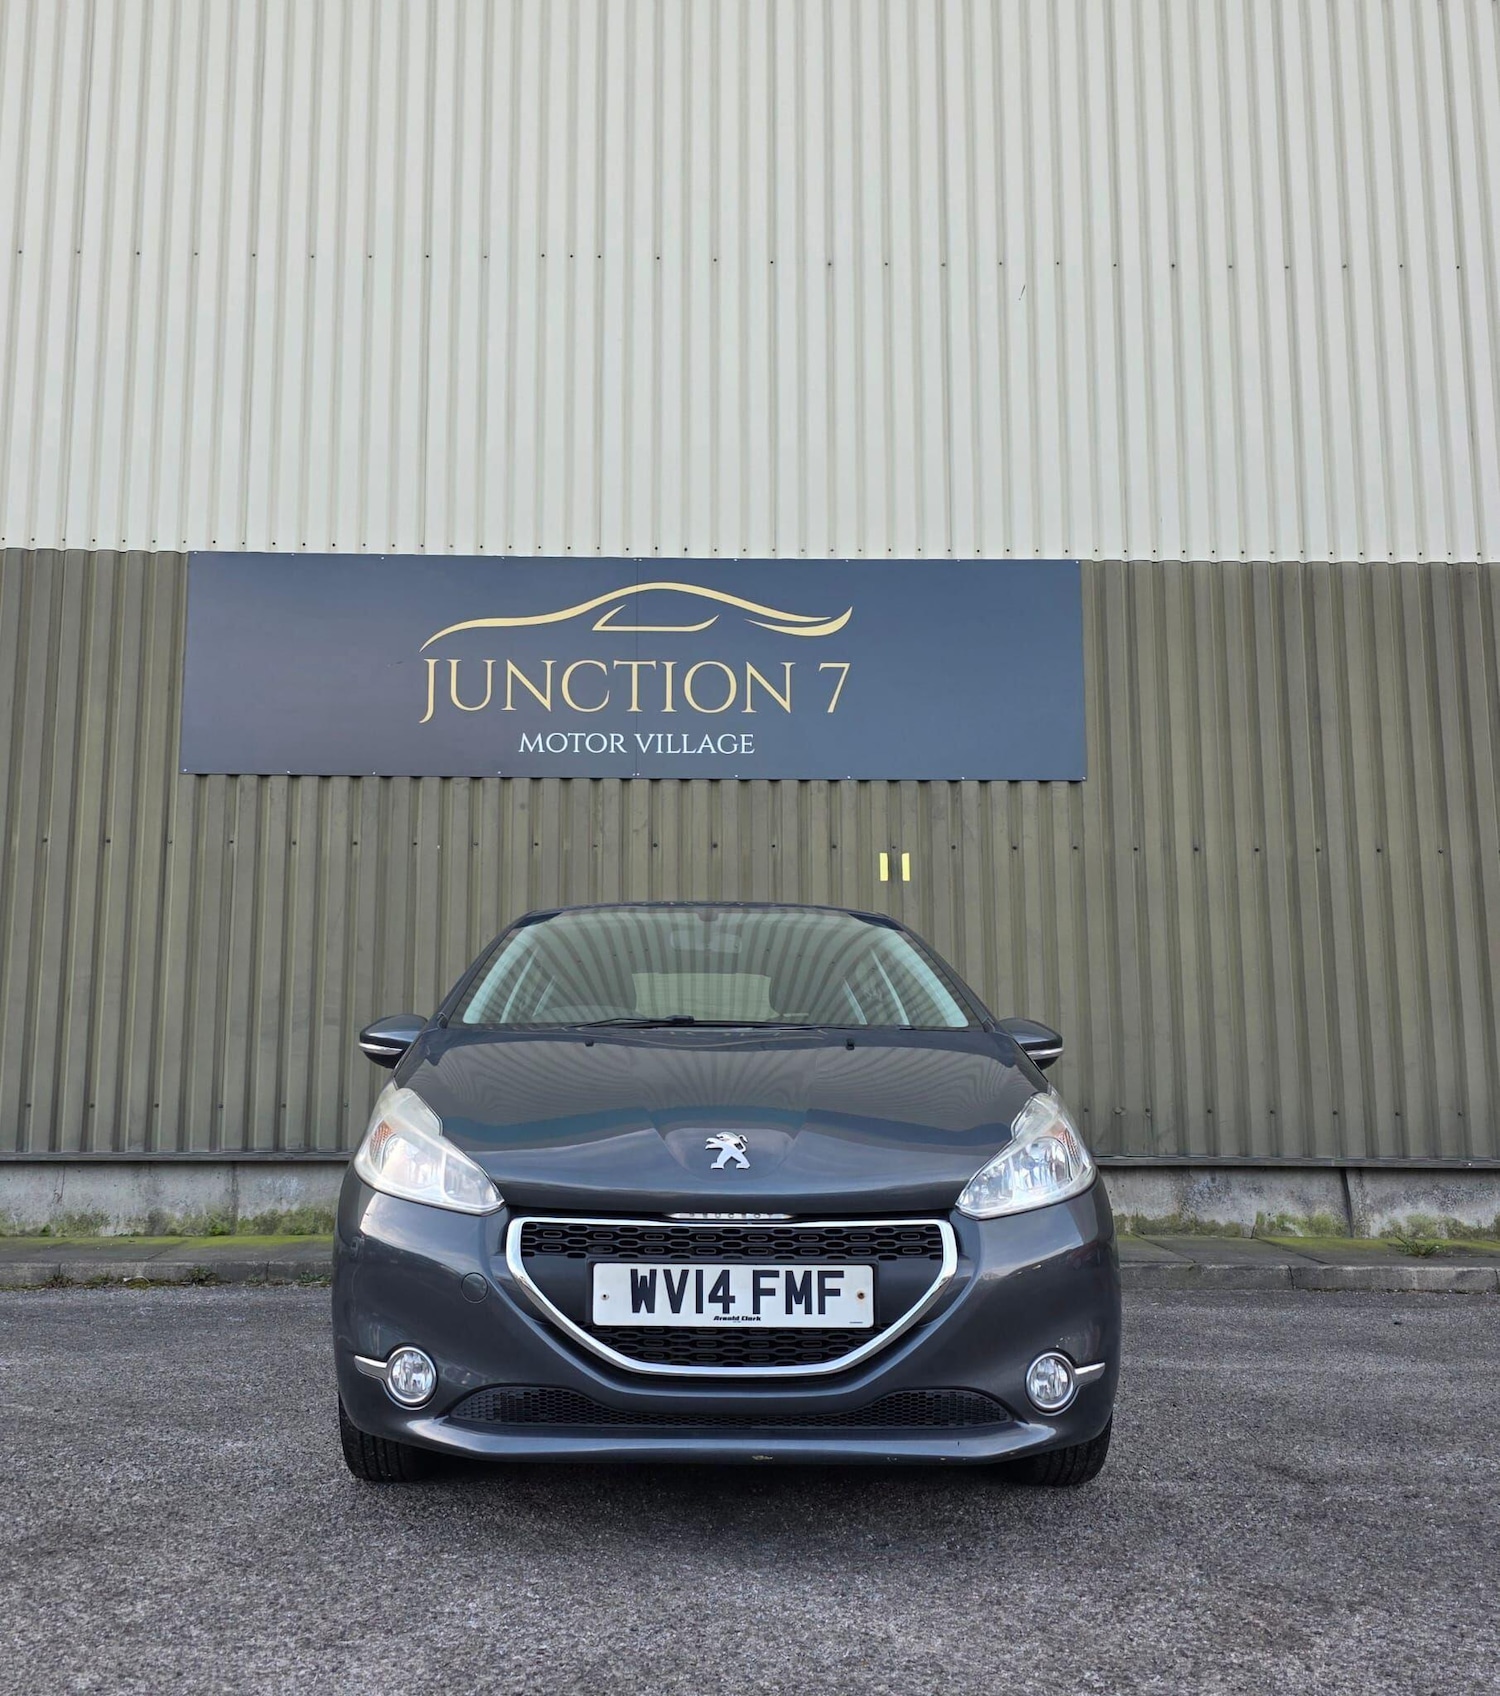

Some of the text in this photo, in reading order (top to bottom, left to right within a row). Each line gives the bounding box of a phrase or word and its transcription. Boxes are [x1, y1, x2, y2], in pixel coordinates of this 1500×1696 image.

[418, 658, 851, 723] JUNCTION 7
[518, 732, 756, 755] MOTOR VILLAGE
[631, 1269, 845, 1315] WV14 FMF
